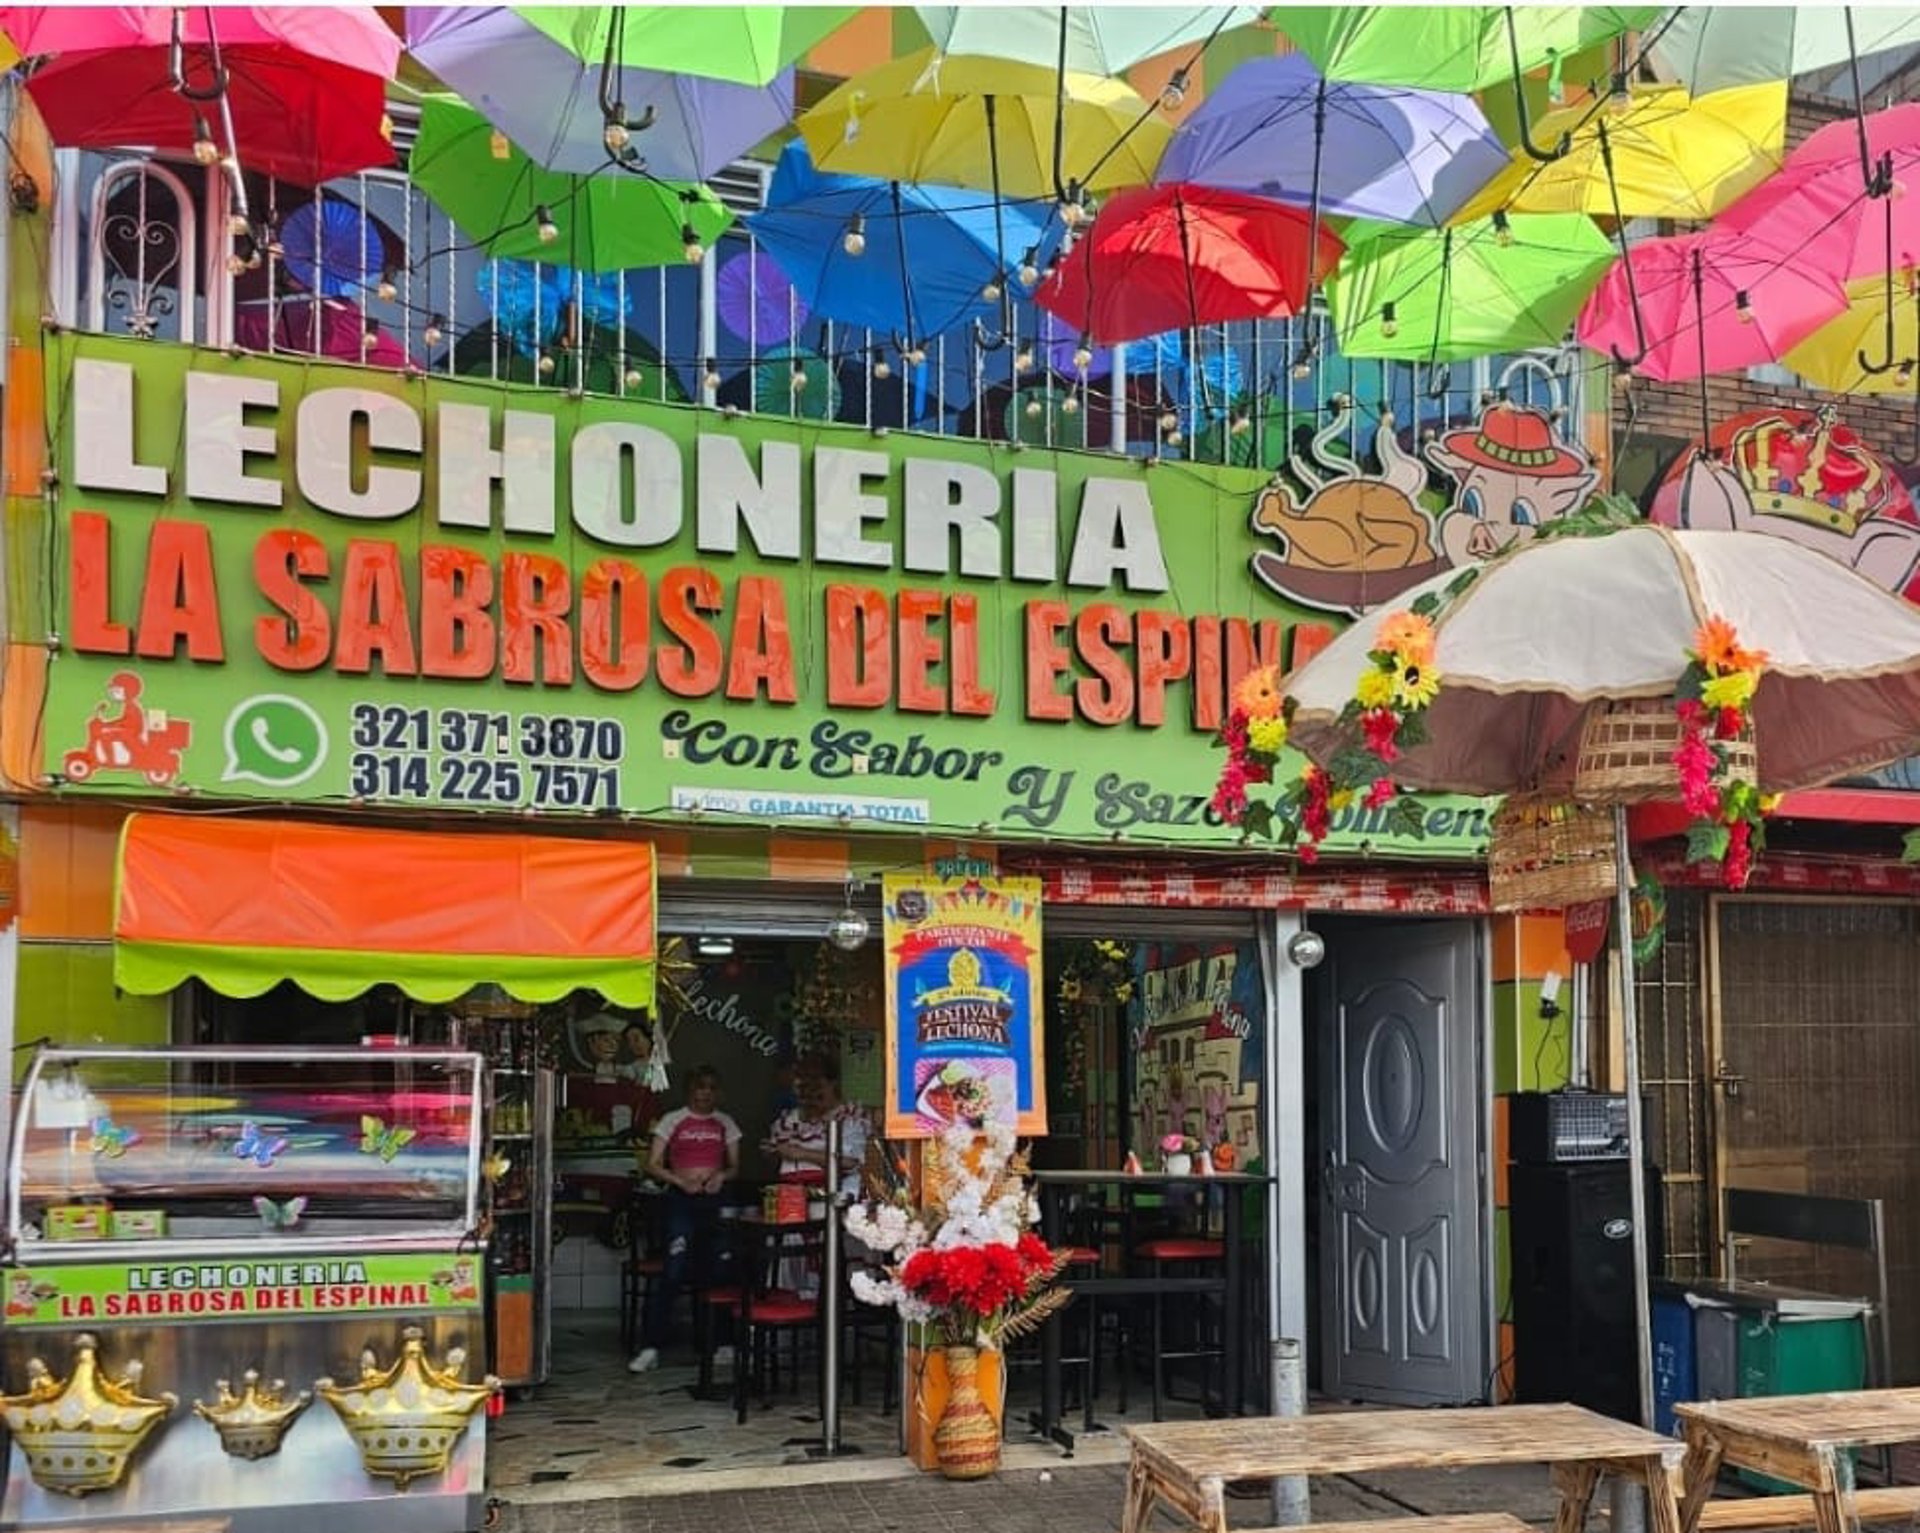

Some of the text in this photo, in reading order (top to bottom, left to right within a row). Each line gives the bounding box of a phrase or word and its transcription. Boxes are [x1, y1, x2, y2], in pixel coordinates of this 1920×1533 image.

[72, 357, 1169, 593] LECHONERIA
[70, 511, 225, 664] LA
[254, 529, 797, 702] SABROSA
[826, 583, 996, 718] DEL
[353, 703, 623, 762] 321 371 3870
[660, 710, 801, 770] Con
[810, 720, 1003, 780] Sabor
[352, 752, 620, 808] 314 225 7571
[863, 803, 927, 823] TOTAL
[924, 1003, 1002, 1021] FESTIVAL
[925, 1022, 1005, 1043] LECHONA
[128, 1262, 368, 1291] LECHONERIA
[61, 1284, 430, 1317] LA SABROSA DEL ESPINAL
